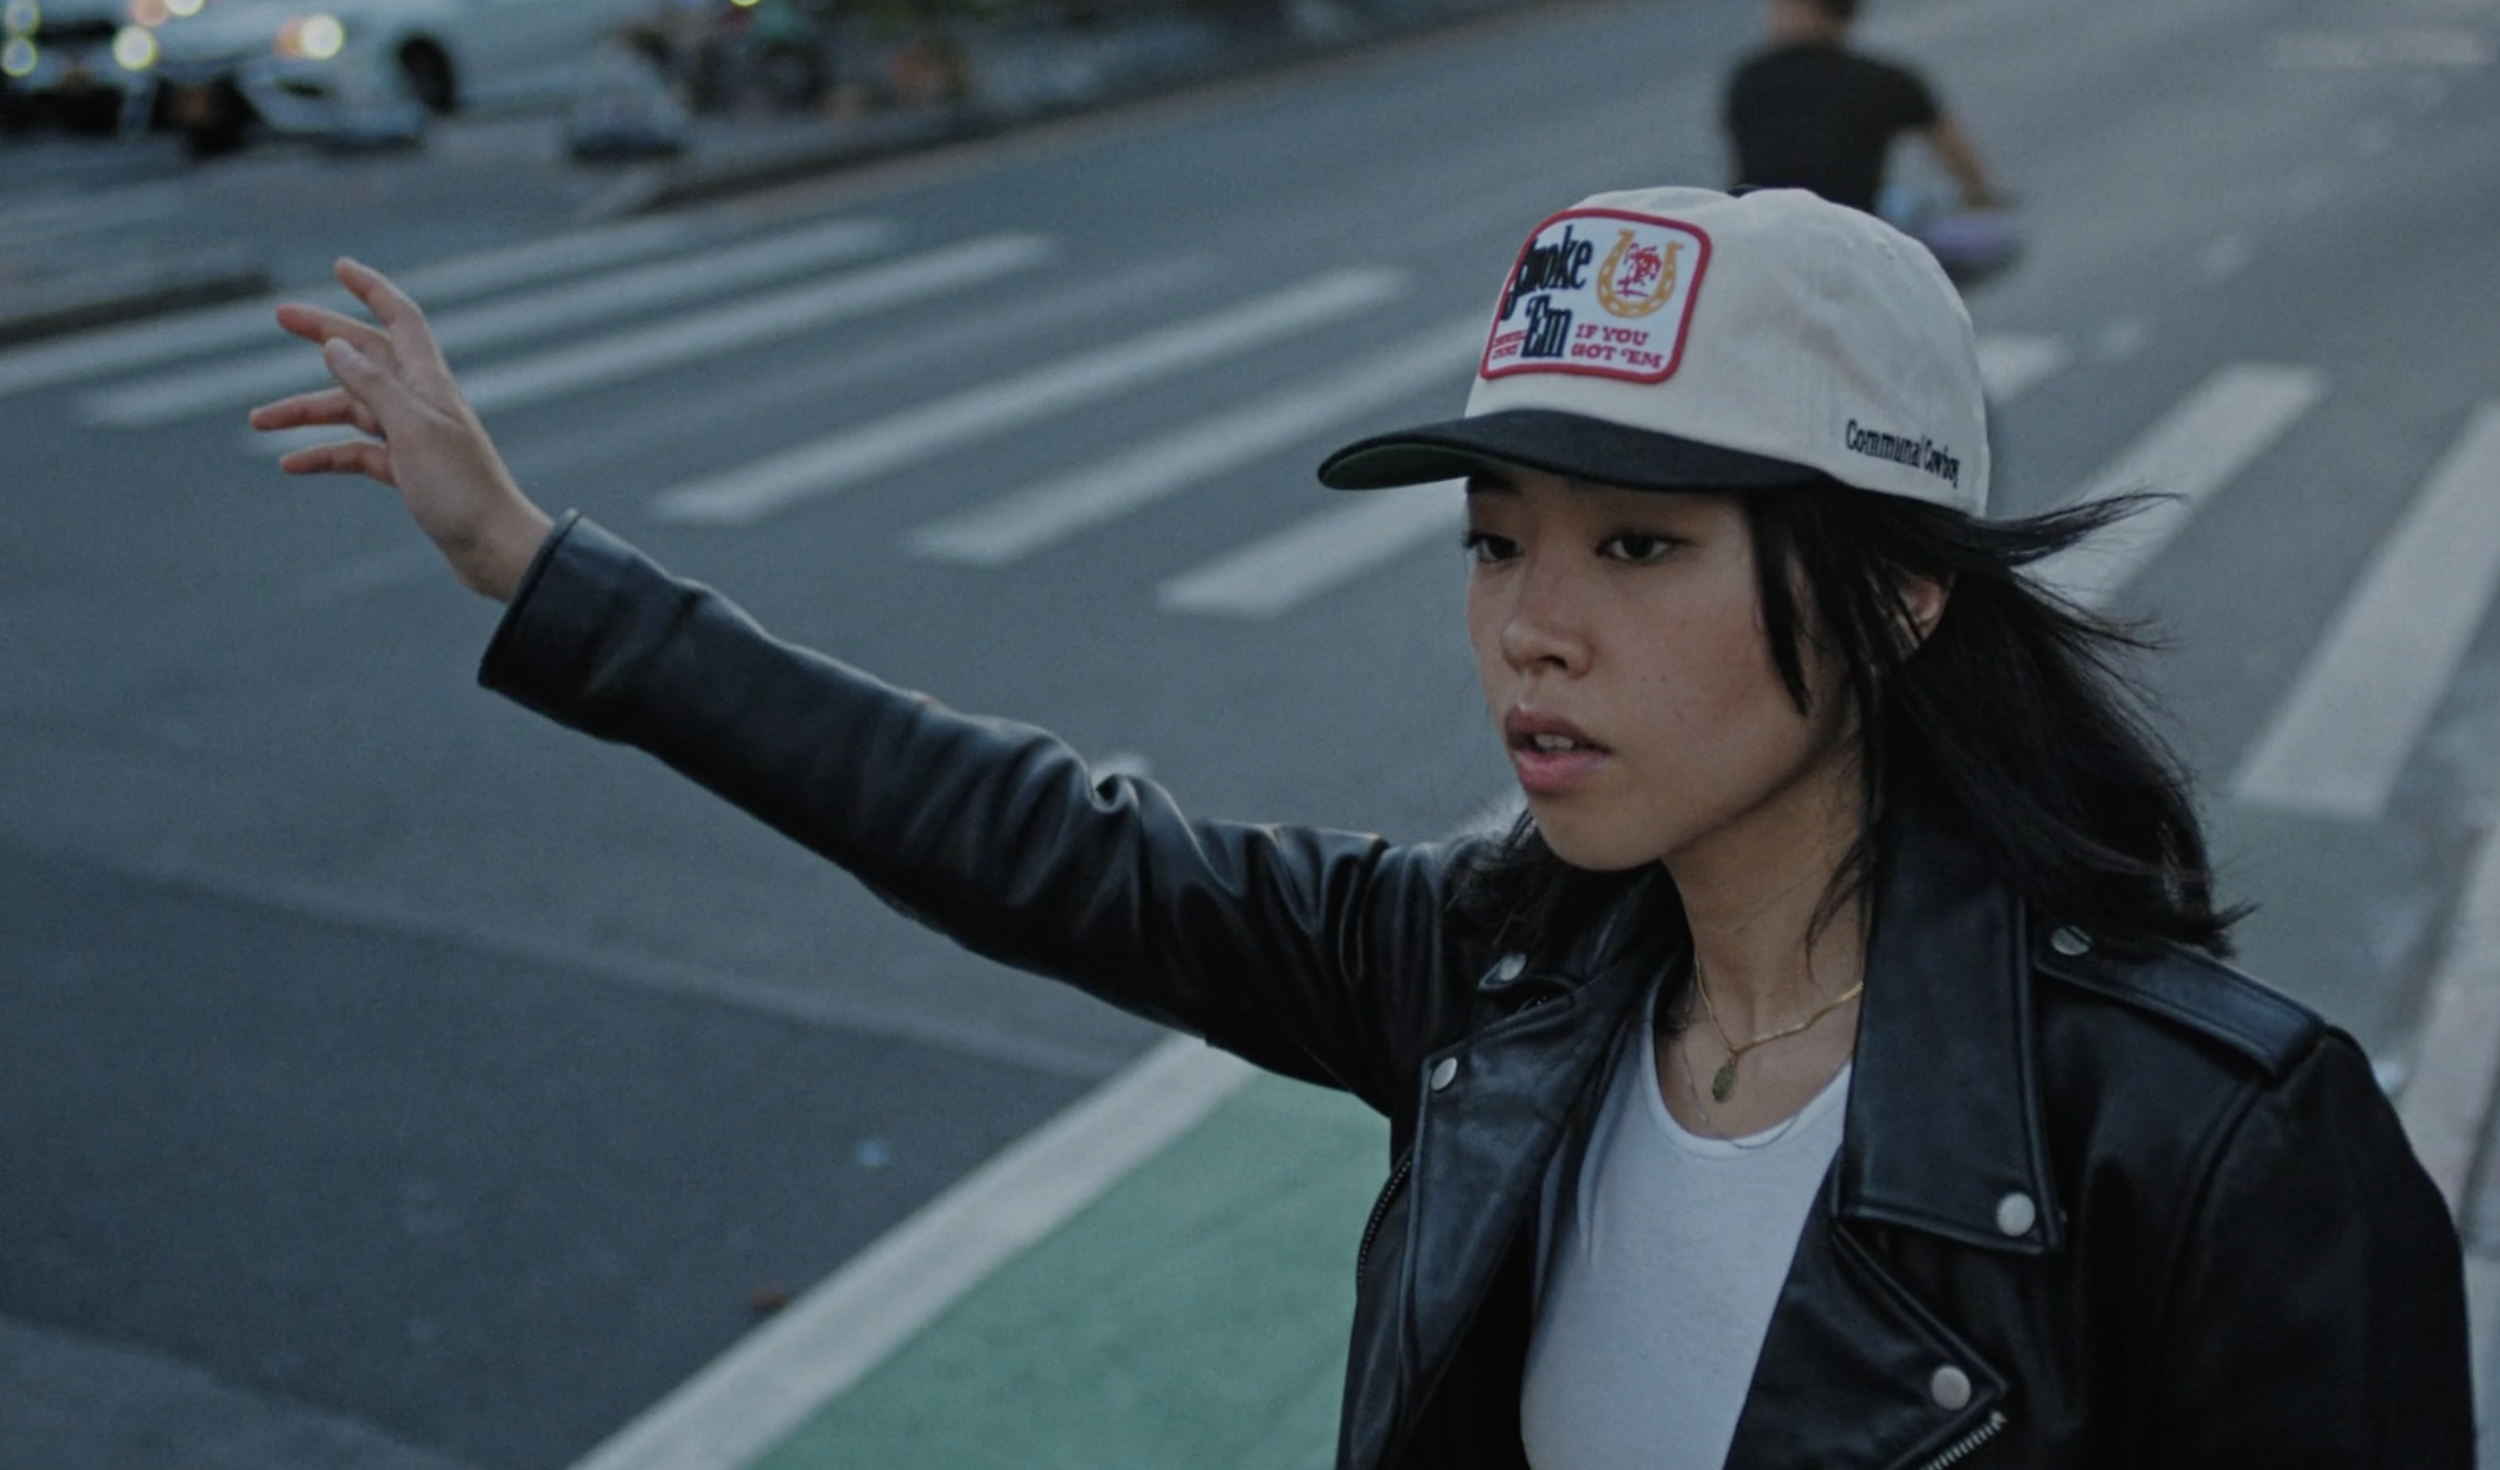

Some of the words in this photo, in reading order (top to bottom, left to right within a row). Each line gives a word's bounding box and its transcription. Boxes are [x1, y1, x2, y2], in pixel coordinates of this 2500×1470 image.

[1575, 323, 1599, 339] IF
[1602, 325, 1650, 347] YOU
[1571, 342, 1617, 361] GOT
[1846, 418, 1924, 469] Communal
